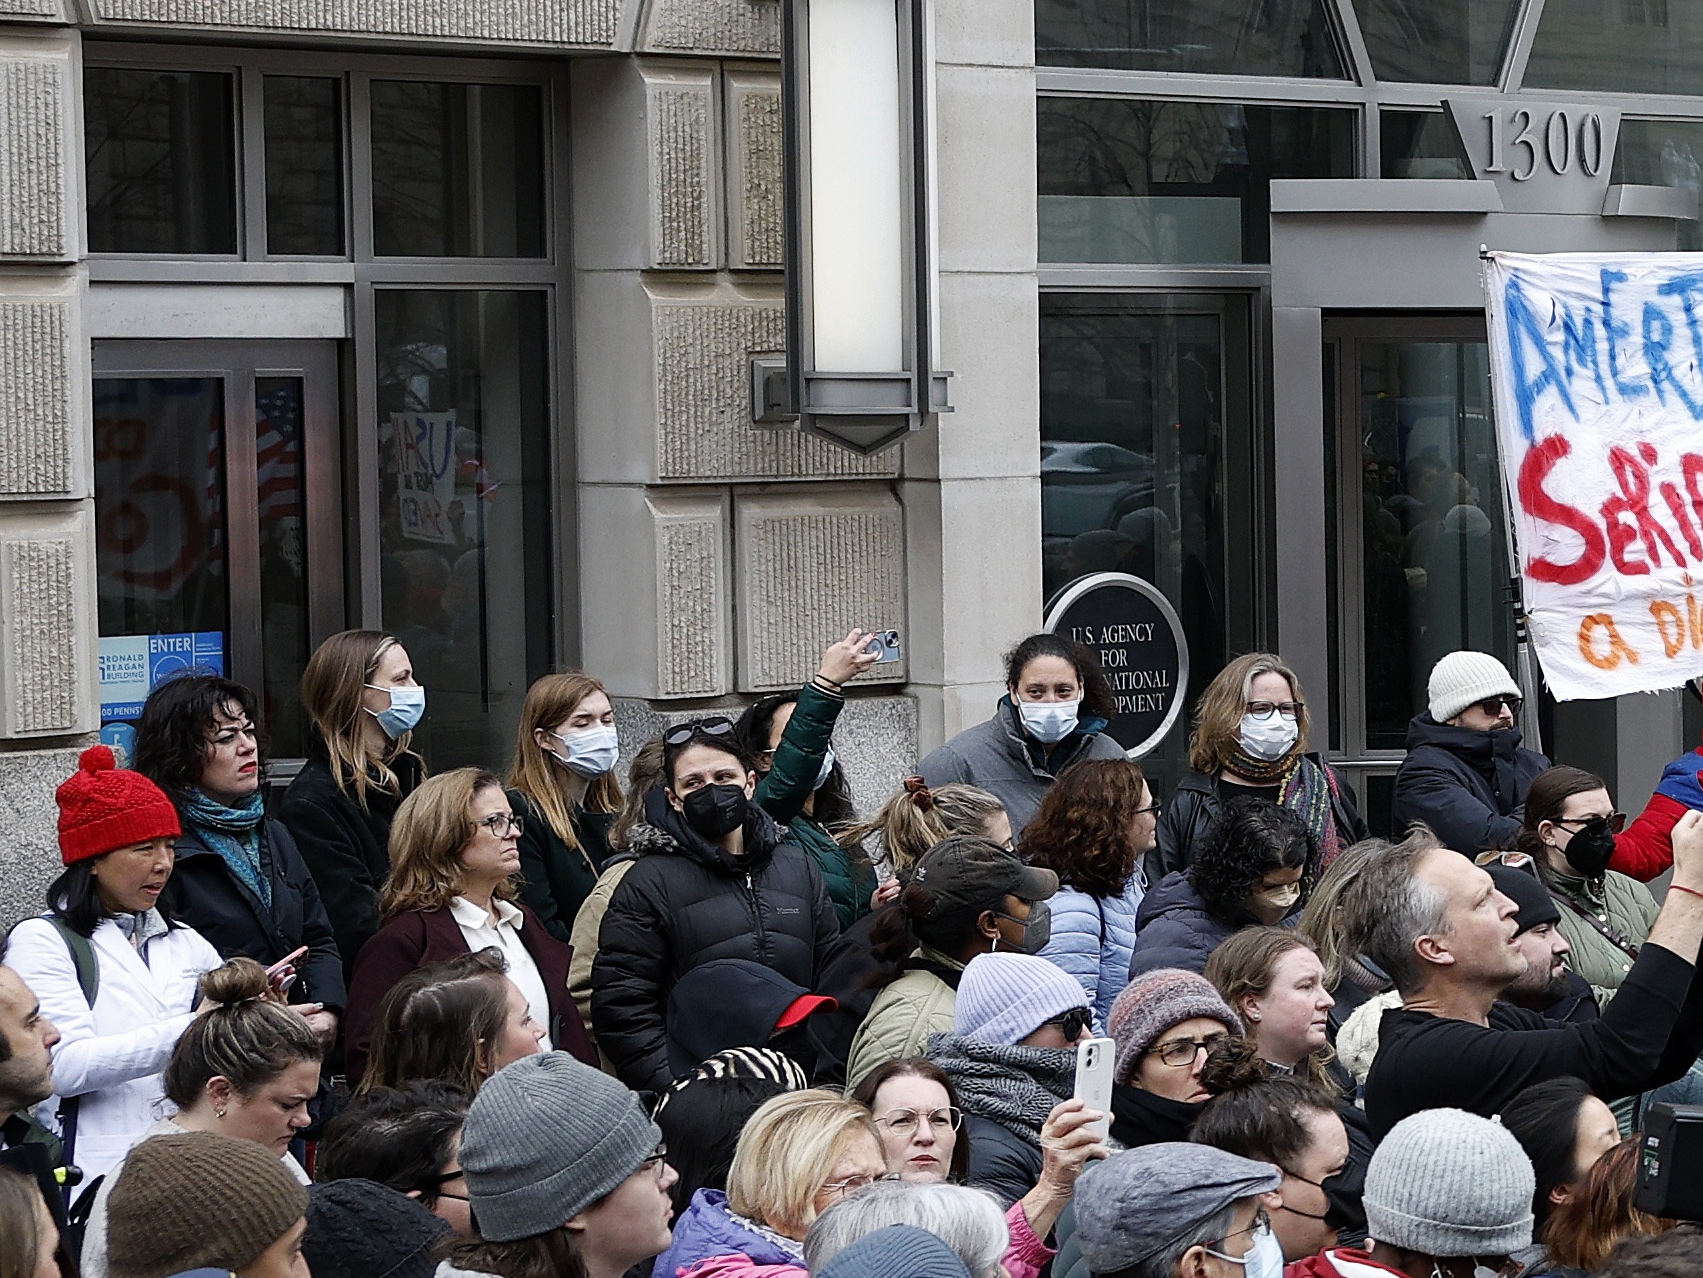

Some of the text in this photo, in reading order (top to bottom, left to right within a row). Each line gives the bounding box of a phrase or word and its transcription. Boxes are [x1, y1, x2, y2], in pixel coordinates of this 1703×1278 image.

[1482, 107, 1602, 182] 1300
[1100, 623, 1155, 644] AGENCY
[1577, 612, 1639, 670] a
[150, 638, 191, 653] ENTER
[106, 654, 144, 662] RONALD
[1100, 649, 1127, 667] FOR
[106, 663, 145, 671] REAGAN
[106, 671, 145, 680] BUILDING
